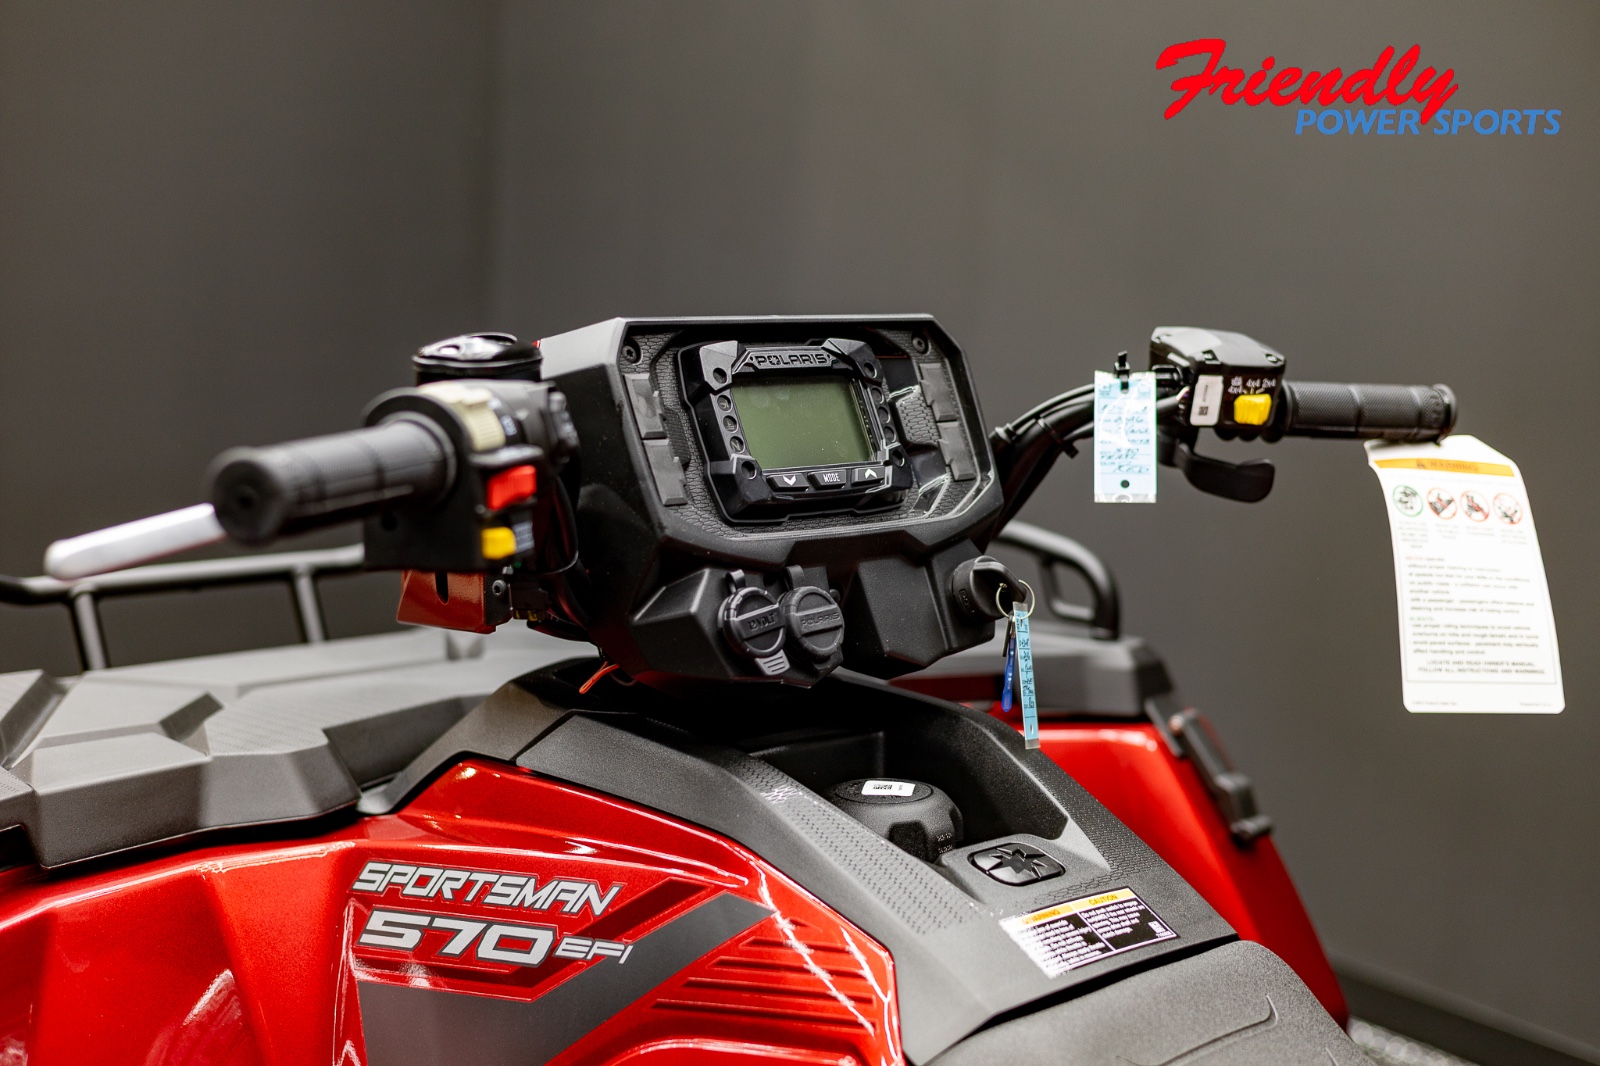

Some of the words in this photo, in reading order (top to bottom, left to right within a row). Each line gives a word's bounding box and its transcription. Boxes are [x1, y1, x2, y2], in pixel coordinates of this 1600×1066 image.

[755, 352, 828, 367] POLARIS
[822, 472, 841, 483] MODE
[800, 612, 841, 628] POLARIS
[351, 861, 621, 916] SPORTSMAN
[1088, 894, 1119, 906] CAUTION
[358, 909, 556, 968] 570
[554, 937, 633, 965] EFI
